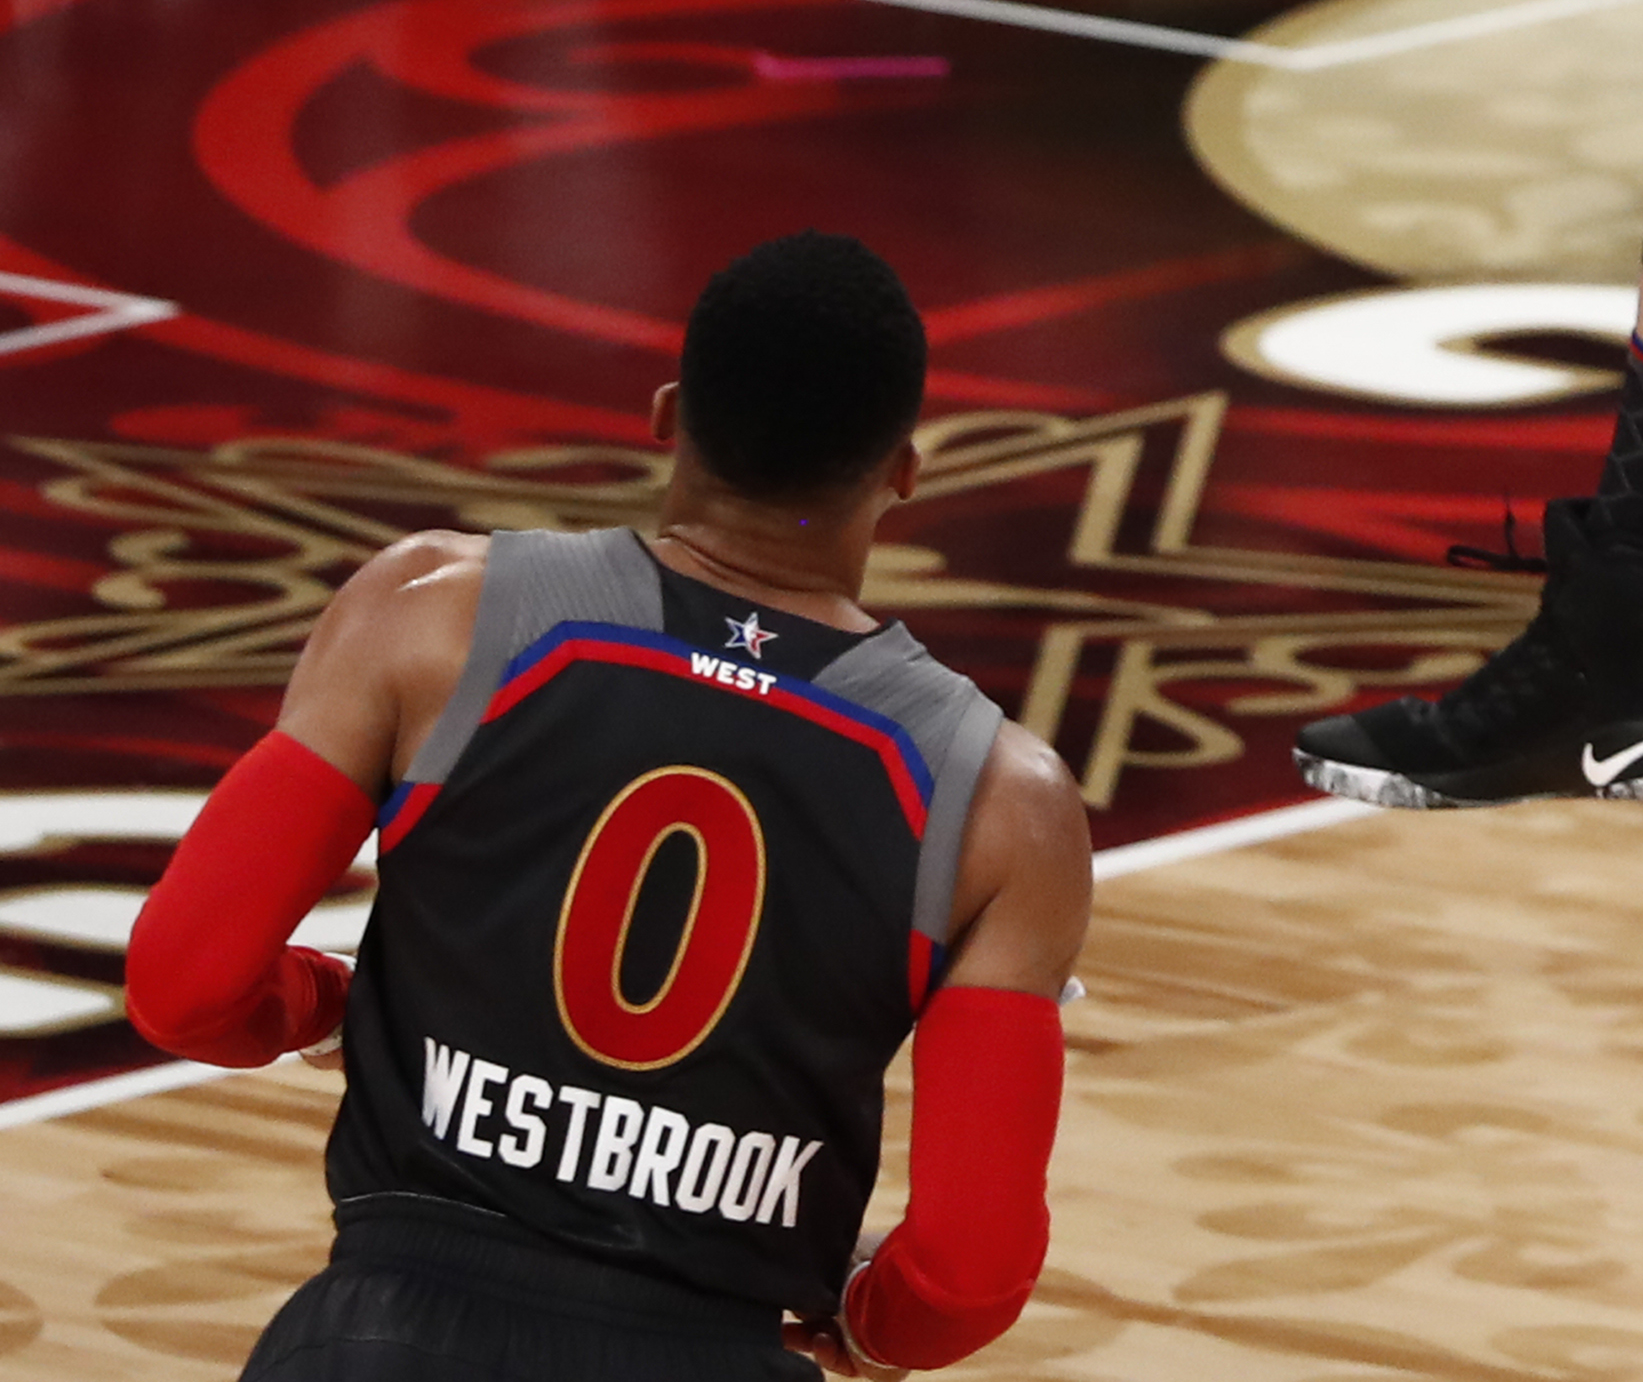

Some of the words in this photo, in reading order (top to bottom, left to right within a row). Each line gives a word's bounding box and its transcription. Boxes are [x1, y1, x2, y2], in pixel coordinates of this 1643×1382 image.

[689, 650, 779, 696] WEST
[552, 763, 768, 1073] 0
[420, 1035, 825, 1229] WESTBROOK
